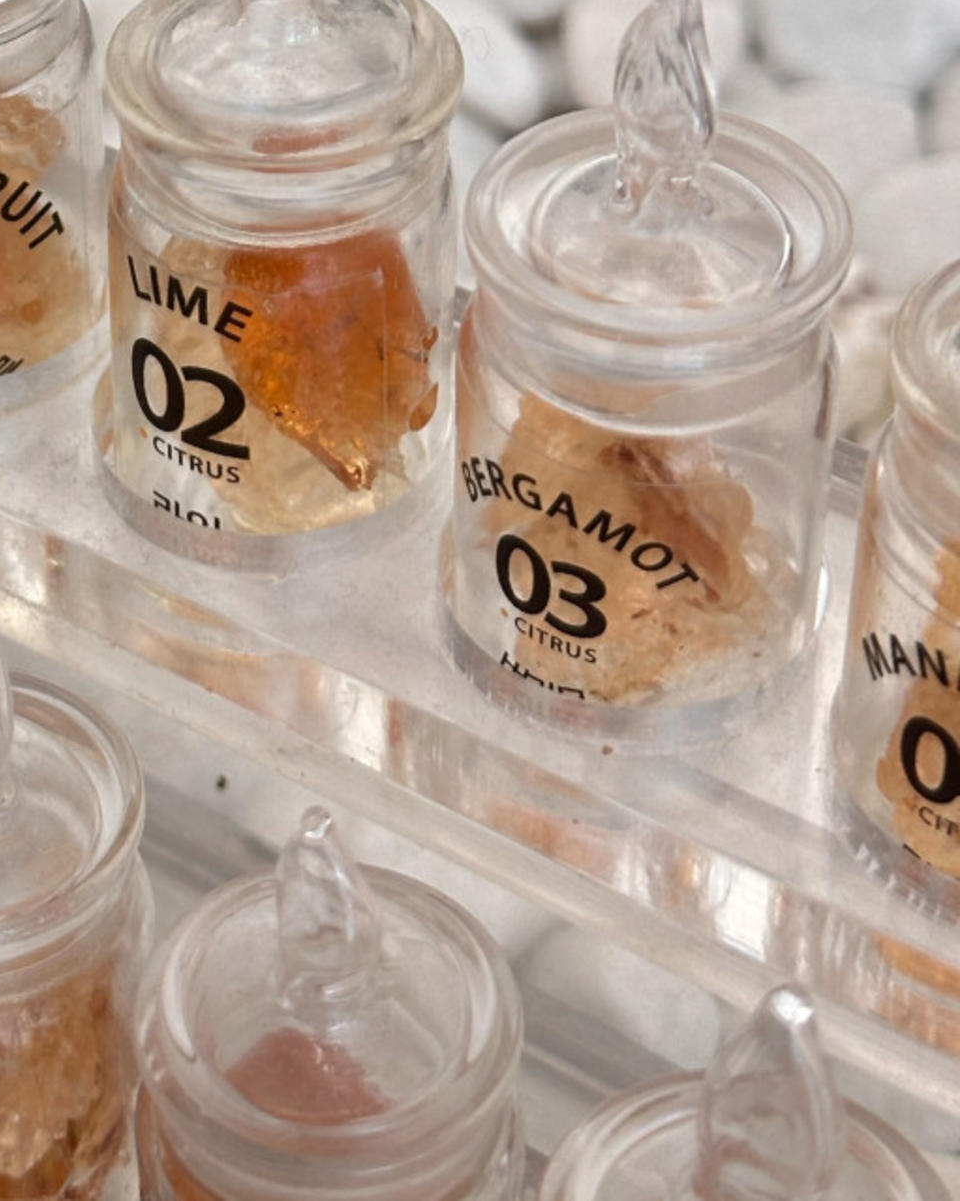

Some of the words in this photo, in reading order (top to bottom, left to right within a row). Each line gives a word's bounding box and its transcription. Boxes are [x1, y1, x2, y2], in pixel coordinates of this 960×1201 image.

[128, 255, 254, 343] LIME
[131, 337, 251, 461] 02
[152, 436, 241, 484] CITRUS
[461, 457, 699, 591] BERGAMOT
[496, 534, 608, 639] 03
[514, 616, 597, 664] CITRUS
[862, 632, 960, 692] MAN
[900, 715, 960, 804] 0
[918, 805, 960, 837] CIT
